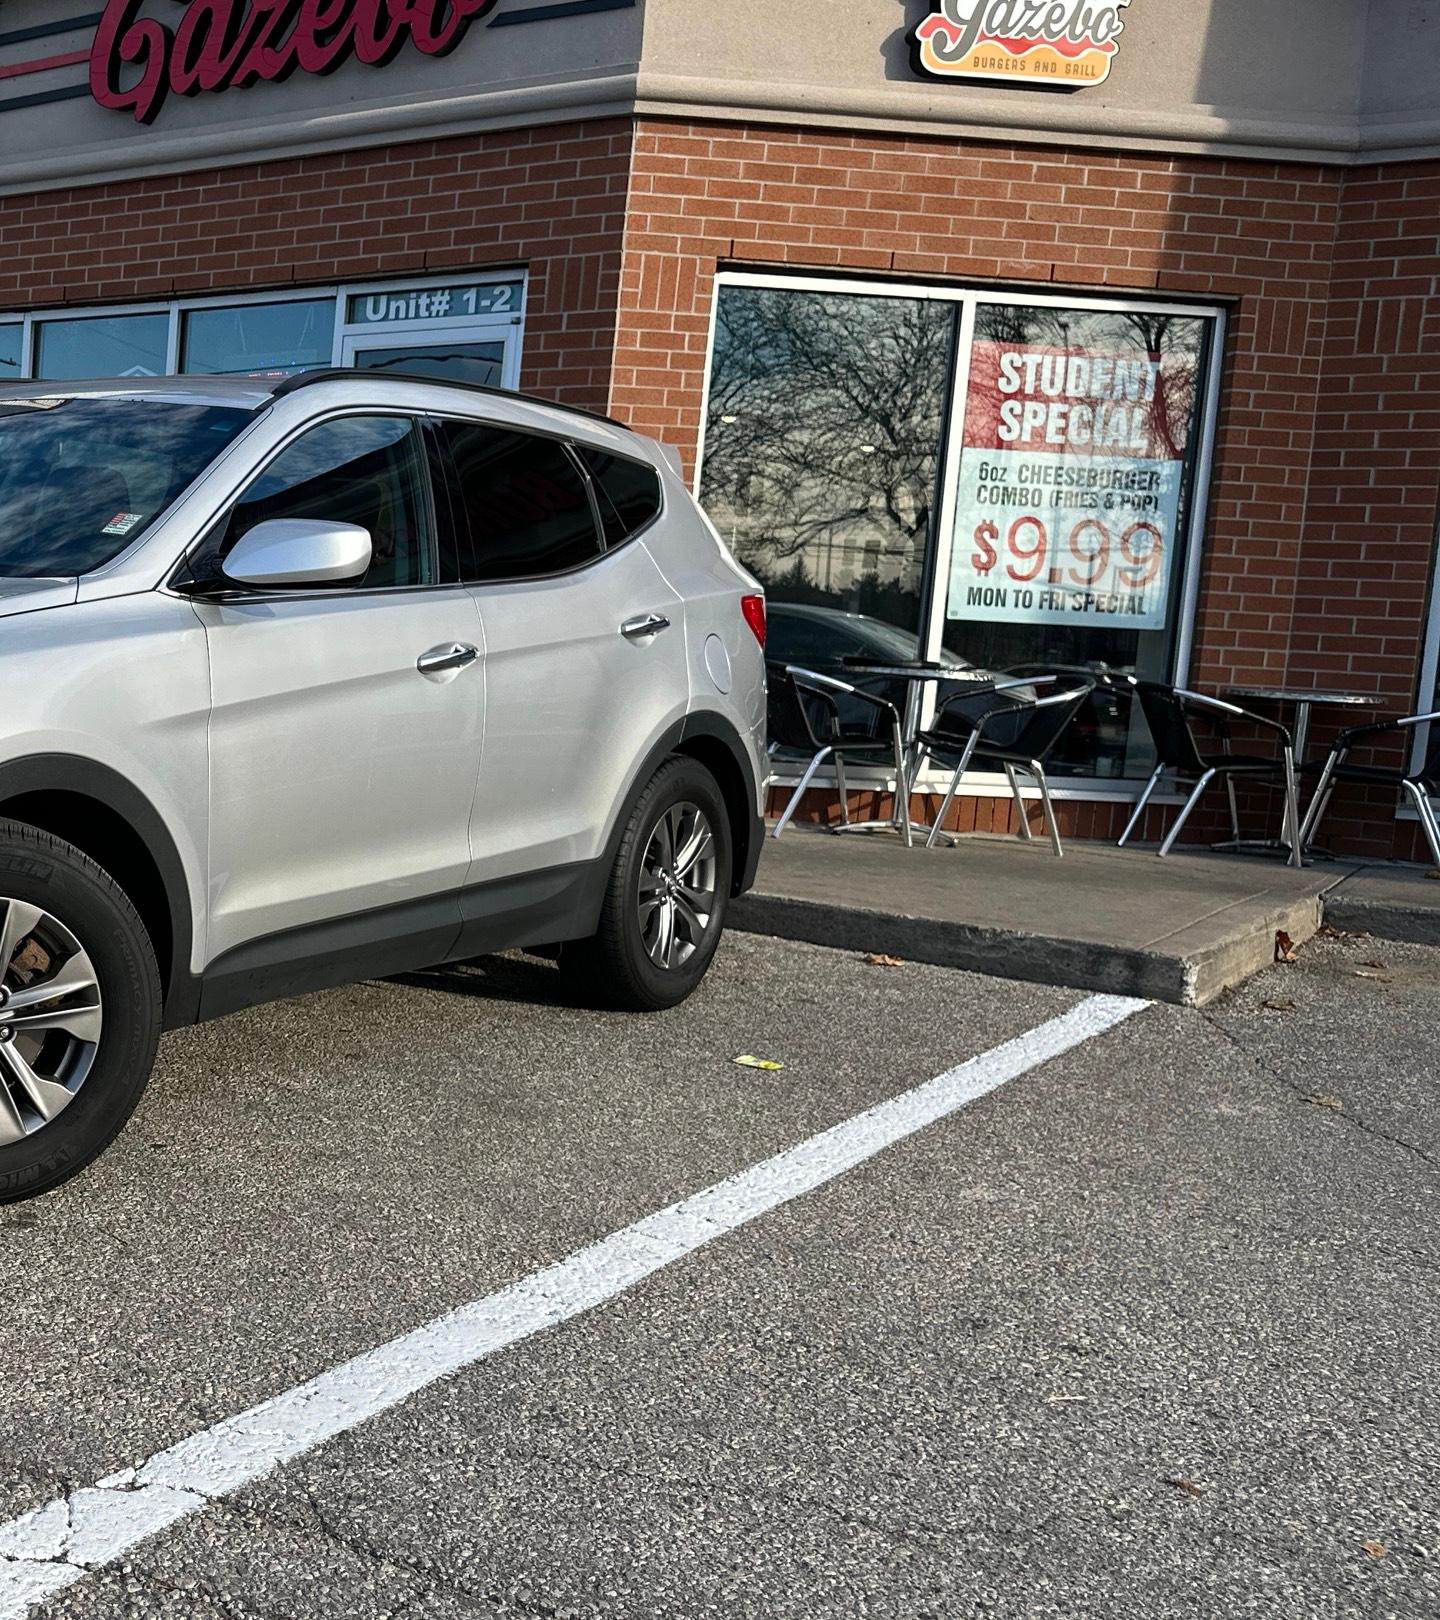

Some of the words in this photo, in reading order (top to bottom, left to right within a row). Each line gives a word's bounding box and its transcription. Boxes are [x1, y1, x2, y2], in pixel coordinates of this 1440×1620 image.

[973, 56, 1026, 71] BURGERS
[1034, 60, 1057, 74] AND
[1065, 63, 1096, 77] GRILL
[366, 288, 450, 322] Unit#
[462, 285, 512, 314] 1-2
[997, 352, 1161, 401] STUDENT
[997, 400, 1150, 449] SPECIAL
[1018, 463, 1162, 491] CHEESEBURGER
[976, 484, 1043, 508] COMBO
[1049, 489, 1098, 510] (FRIES
[1103, 493, 1115, 510] &
[1120, 494, 1159, 513] POP)
[971, 515, 1164, 589] $9.99
[967, 587, 1007, 608] MON
[1013, 589, 1033, 610] TO
[1038, 590, 1066, 612] FRI
[1071, 592, 1147, 616] SPECIAL
